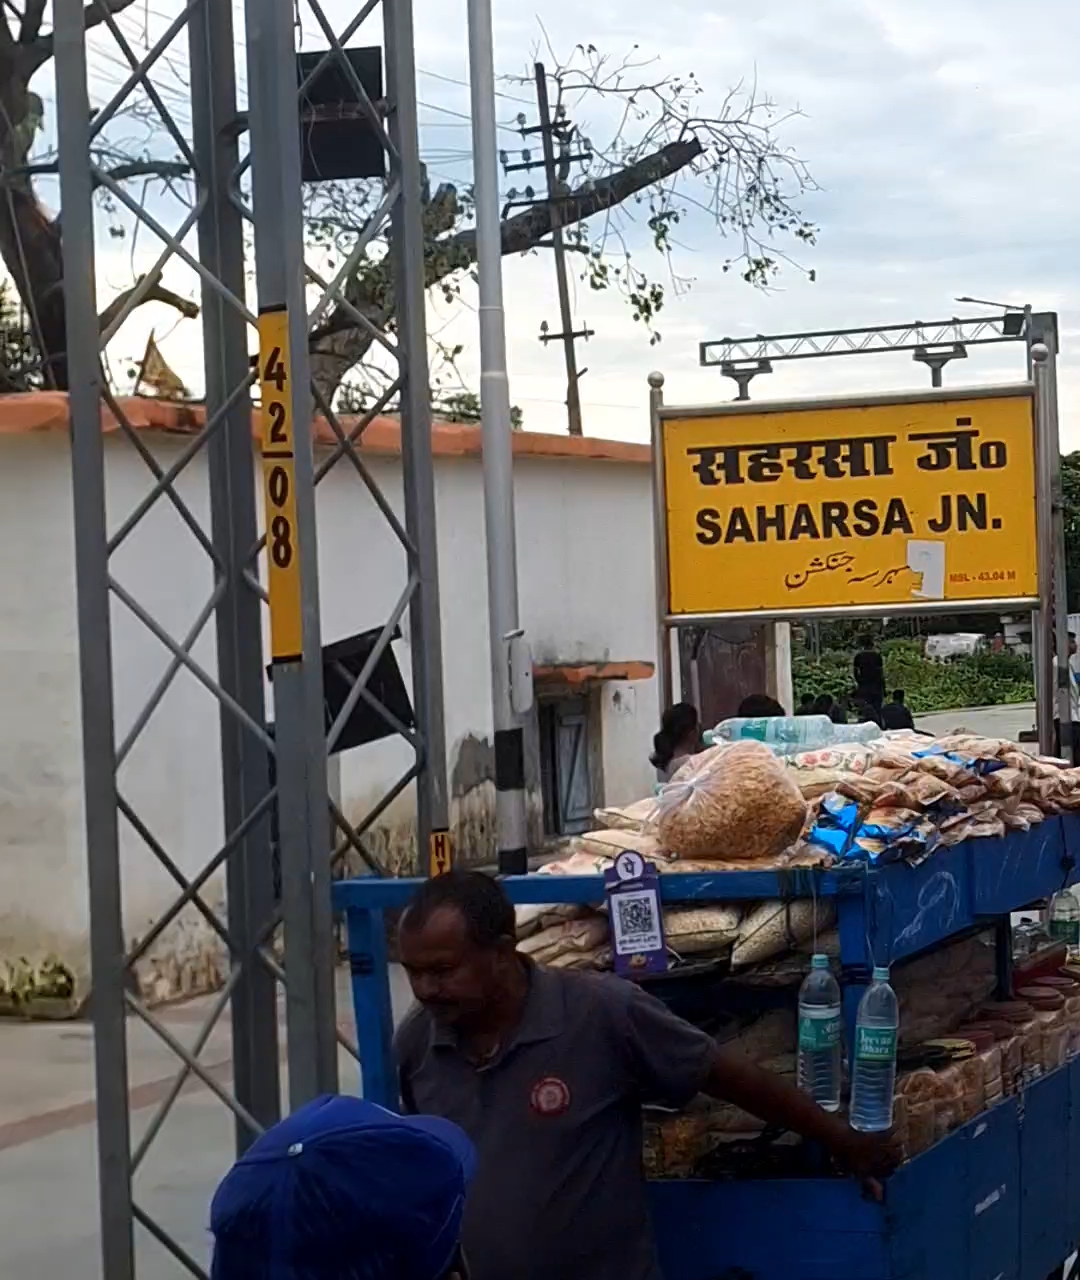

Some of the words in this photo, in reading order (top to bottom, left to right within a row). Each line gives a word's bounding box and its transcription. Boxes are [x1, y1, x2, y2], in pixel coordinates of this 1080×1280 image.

[686, 435, 897, 486] सहरसा
[695, 497, 914, 545] SAHARSA
[928, 493, 1002, 532] JN.
